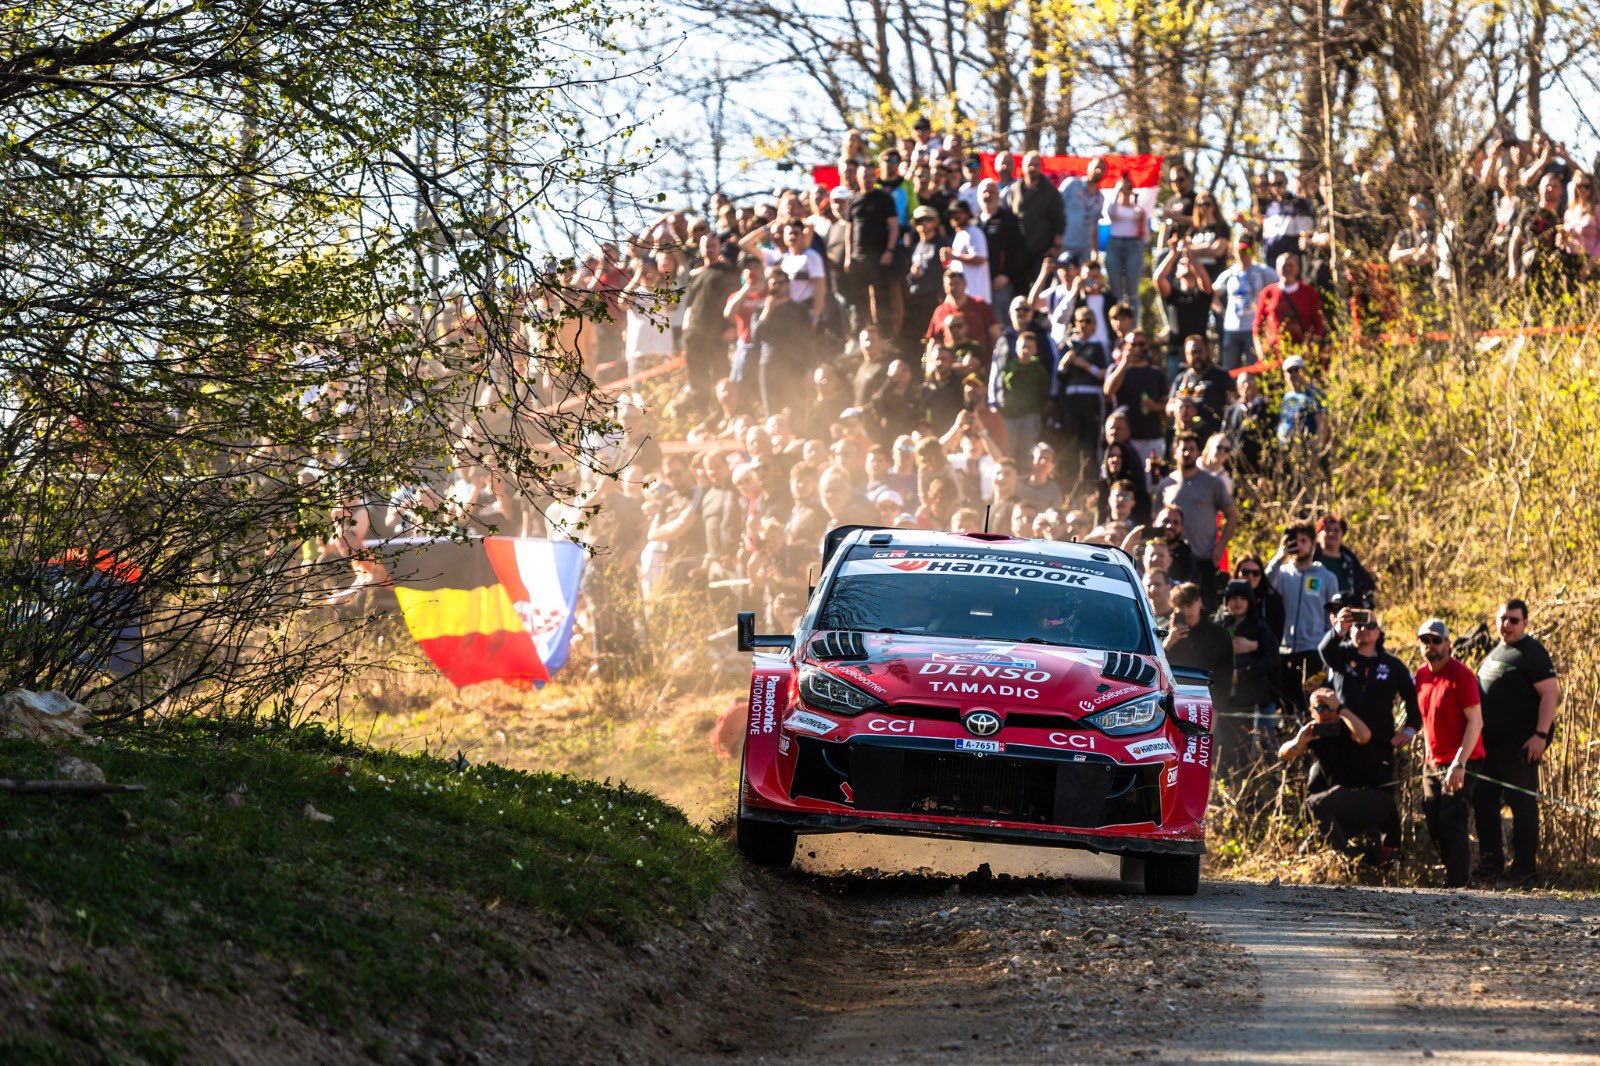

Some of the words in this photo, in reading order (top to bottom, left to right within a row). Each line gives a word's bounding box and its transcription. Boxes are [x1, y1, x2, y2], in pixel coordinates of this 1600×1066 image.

[911, 552, 979, 560] TOYOTA
[983, 554, 1046, 565] GAZOO
[1049, 561, 1105, 576] Racing
[918, 662, 1052, 683] DENSO
[928, 681, 1040, 700] TAMADIC
[749, 674, 765, 735] AUTOMOTIVE
[763, 675, 781, 734] Panasonic
[965, 741, 996, 750] A-7651
